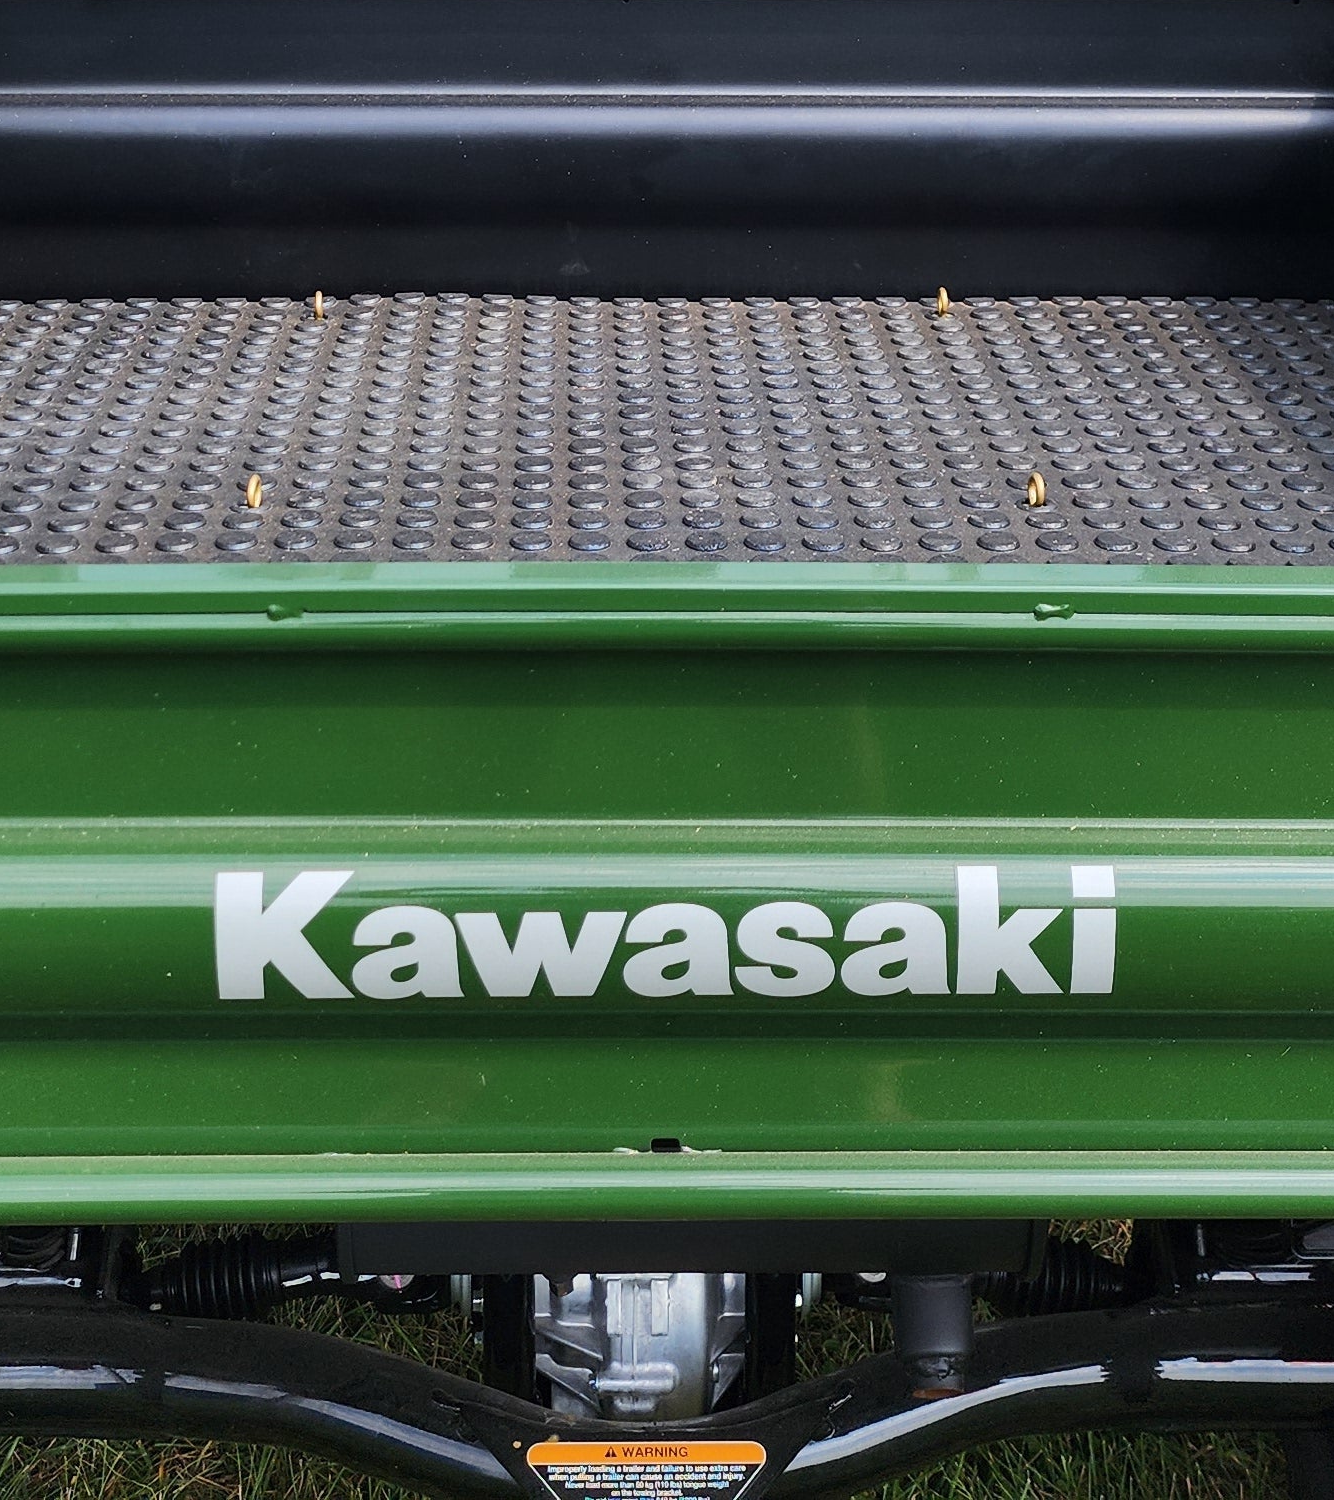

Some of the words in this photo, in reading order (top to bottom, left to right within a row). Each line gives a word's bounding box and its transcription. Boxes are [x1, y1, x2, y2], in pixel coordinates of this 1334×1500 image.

[215, 865, 1117, 1000] Kawasaki
[622, 1446, 688, 1457] WARNING
[547, 1465, 587, 1474] Improperly
[588, 1465, 615, 1473] loading
[622, 1465, 645, 1473] trailer
[548, 1473, 569, 1481] when
[569, 1473, 594, 1482] pulling
